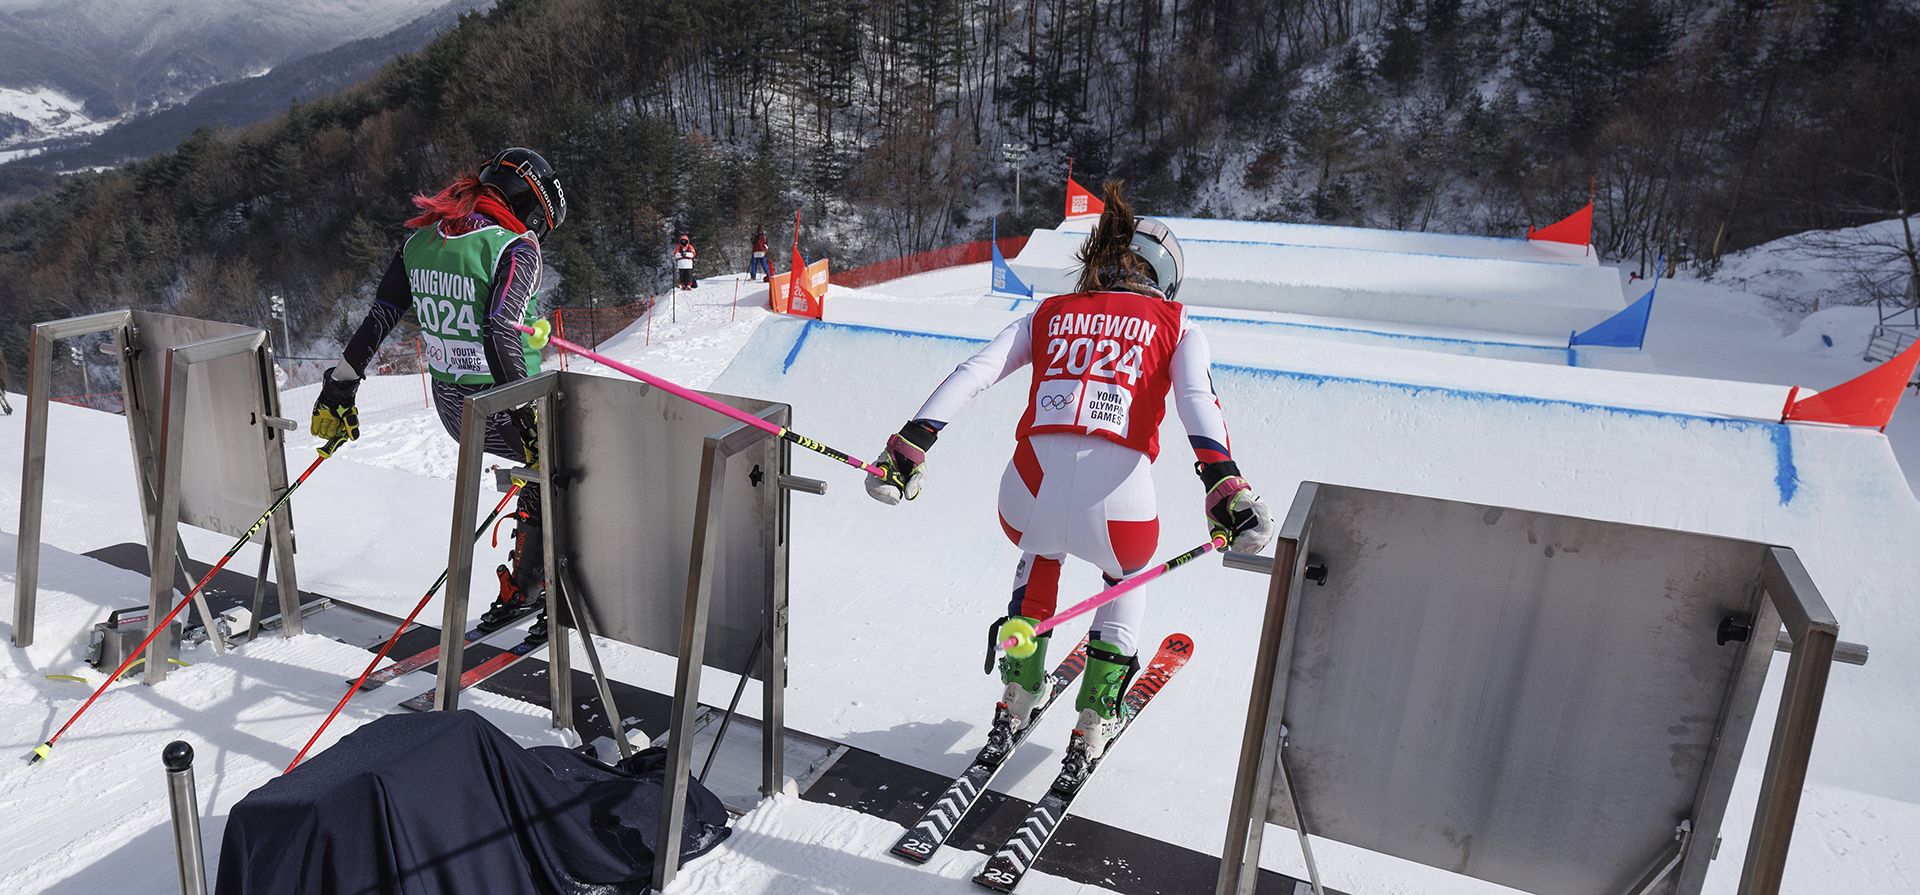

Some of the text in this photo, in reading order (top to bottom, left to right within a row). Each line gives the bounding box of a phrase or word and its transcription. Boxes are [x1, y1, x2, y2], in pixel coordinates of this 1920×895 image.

[553, 178, 566, 208] POC
[410, 268, 476, 302] ANGWON
[412, 295, 481, 337] 2024
[1047, 313, 1158, 347] GANGWON
[450, 356, 482, 366] OLYMPIC
[451, 347, 477, 357] YOUTH
[1044, 337, 1144, 386] 2024
[1091, 410, 1122, 426] GAMES
[797, 436, 826, 453] LEKI
[248, 510, 272, 538] LEKI
[902, 838, 933, 854] 25
[984, 867, 1016, 885] 25
